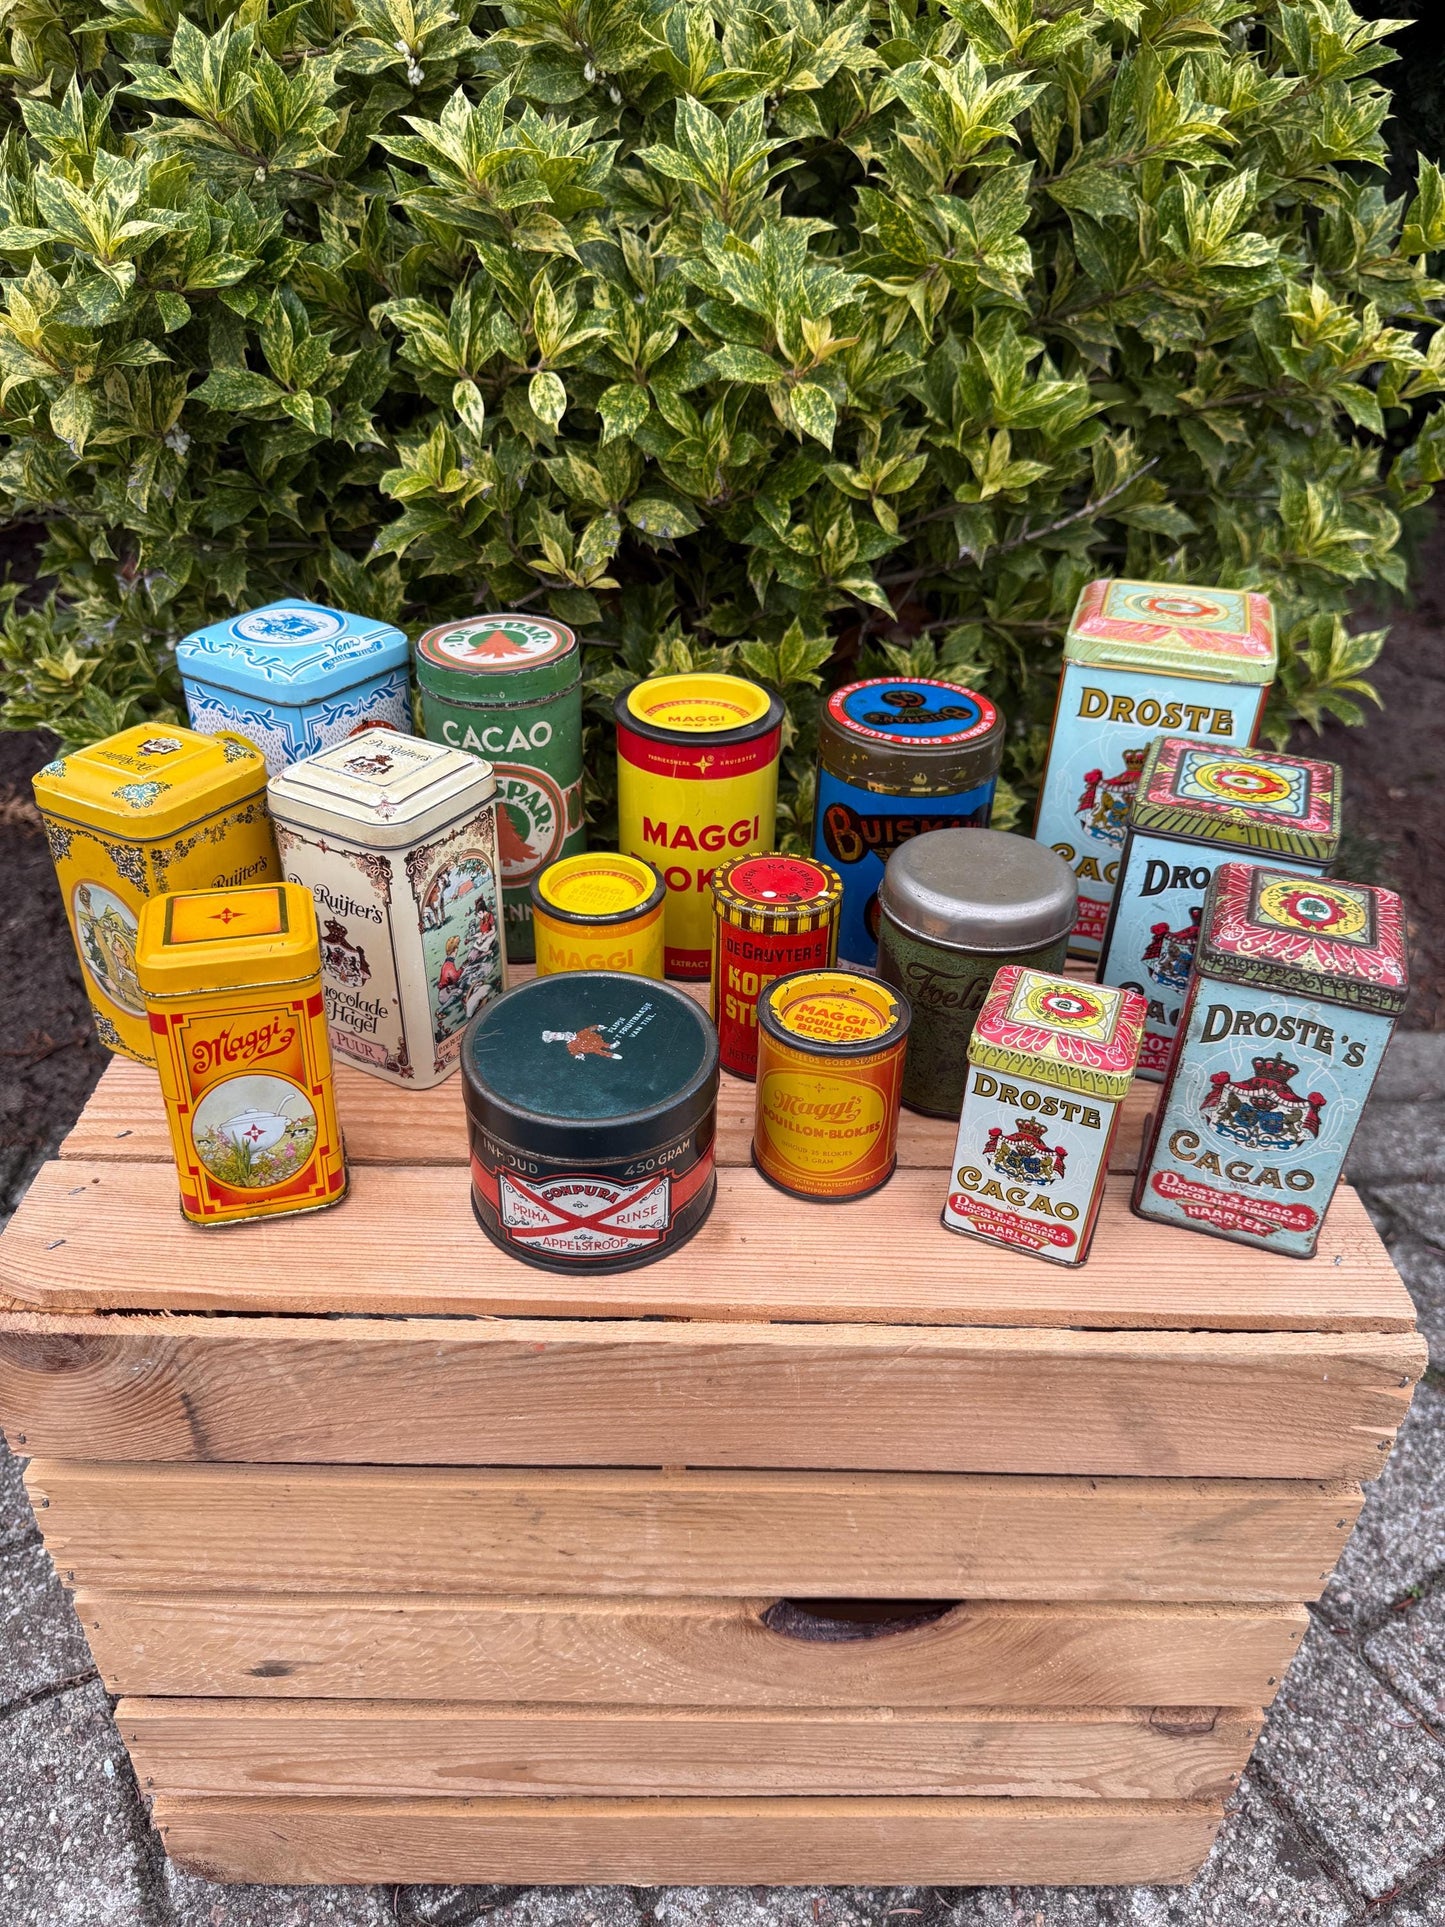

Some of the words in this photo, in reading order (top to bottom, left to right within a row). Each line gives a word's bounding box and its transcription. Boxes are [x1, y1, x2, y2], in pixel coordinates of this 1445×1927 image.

[324, 635, 361, 655] Venz
[443, 629, 476, 643] DE
[484, 622, 552, 640] SPAR
[888, 677, 939, 686] KOFFIE
[943, 682, 975, 697] VOOR
[1076, 686, 1233, 737] DROSTE
[443, 720, 552, 752] CACAO
[843, 720, 894, 740] SLUITEN
[950, 722, 991, 743] GEBRUIK
[643, 815, 760, 852] MAGGI
[789, 866, 814, 893] GEBRUIK
[313, 884, 384, 925] Ruijter's
[549, 944, 634, 970] MAGGI
[670, 959, 709, 968] EXTRACT
[323, 985, 389, 1019] ocolade
[906, 962, 989, 1011] Foeli
[192, 1016, 295, 1074] Maggi
[336, 1031, 374, 1056] PUUR
[629, 1026, 643, 1038] VAN
[1199, 1004, 1367, 1069] DROSTE'S
[972, 1071, 1101, 1130] DROSTE
[763, 1104, 881, 1139] BOUILLON-BLOKJES
[483, 1137, 538, 1174] INHOUD
[624, 1159, 655, 1176] 450
[658, 1138, 690, 1166] GRAM
[1169, 1129, 1315, 1192] CACAO
[794, 1184, 833, 1194] AMSTERDAM
[957, 1166, 1080, 1221] CACAO
[1158, 1184, 1307, 1226] CHOCOLADEFABRIEKEN
[1161, 1173, 1241, 1204] DROSTE'S
[1245, 1200, 1294, 1216] CACAO
[513, 1202, 550, 1224] PRIMA
[616, 1204, 658, 1225] RINSE
[955, 1204, 1068, 1243] CHOCOLADEFABRIEKEN
[956, 1195, 1017, 1222] DROSTE'S
[1019, 1219, 1057, 1234] CACAO
[1188, 1206, 1269, 1232] HAARLEM
[543, 1237, 628, 1251] APPELSTROOP
[978, 1222, 1039, 1247] HAARLEM
